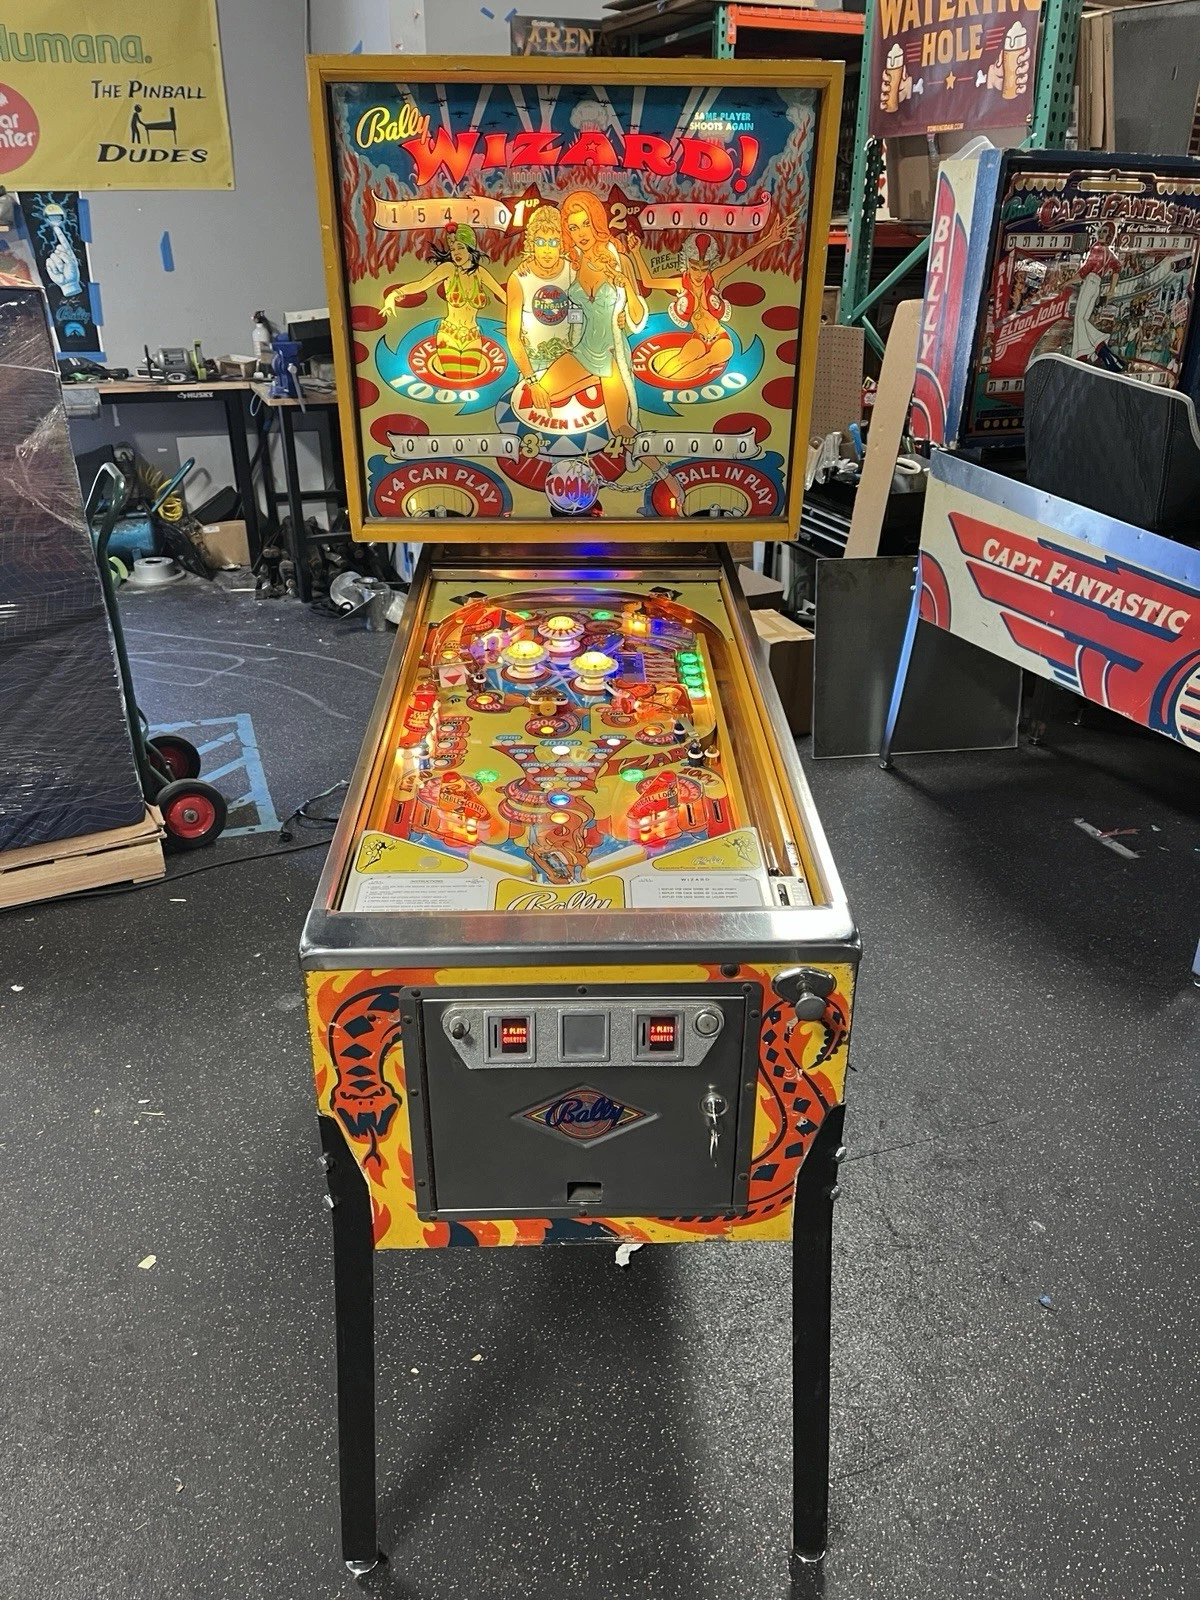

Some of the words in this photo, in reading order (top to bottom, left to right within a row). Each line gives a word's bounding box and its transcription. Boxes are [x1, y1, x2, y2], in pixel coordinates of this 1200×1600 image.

[879, 0, 1043, 40] WATER
[523, 26, 606, 56] AREN
[920, 24, 984, 68] HOLE
[91, 79, 122, 99] THE
[128, 79, 207, 100] PINBALL
[356, 103, 431, 149] Bally
[689, 121, 723, 131] SHOOTS
[725, 121, 754, 131] AGAIN
[694, 112, 719, 121] SAME
[720, 112, 751, 121] PLAYER
[97, 143, 209, 163] DUDES
[400, 126, 760, 194] WIZARD!
[919, 214, 949, 360] BALLY
[412, 341, 437, 374] LOVE
[481, 341, 506, 373] LOVE
[632, 342, 661, 372] EVIL
[187, 391, 214, 399] HUSKY
[389, 374, 481, 403] 1000
[662, 371, 748, 403] 1000
[528, 409, 570, 430] WHEN
[573, 411, 597, 429] LIT
[408, 467, 448, 484] CAN
[454, 468, 498, 504] PLAY
[678, 465, 721, 487] BALL
[724, 466, 743, 482] IN
[743, 473, 773, 507] PLAY
[982, 537, 1043, 580] CAPT.
[1043, 560, 1192, 635] FANTASTIC
[531, 719, 563, 730] 3000
[502, 1036, 527, 1044] QUARTER
[509, 1027, 527, 1035] PLAYS
[650, 1034, 674, 1042] QUARTER
[656, 1026, 674, 1034] PLAYS
[545, 1096, 624, 1127] Bally
